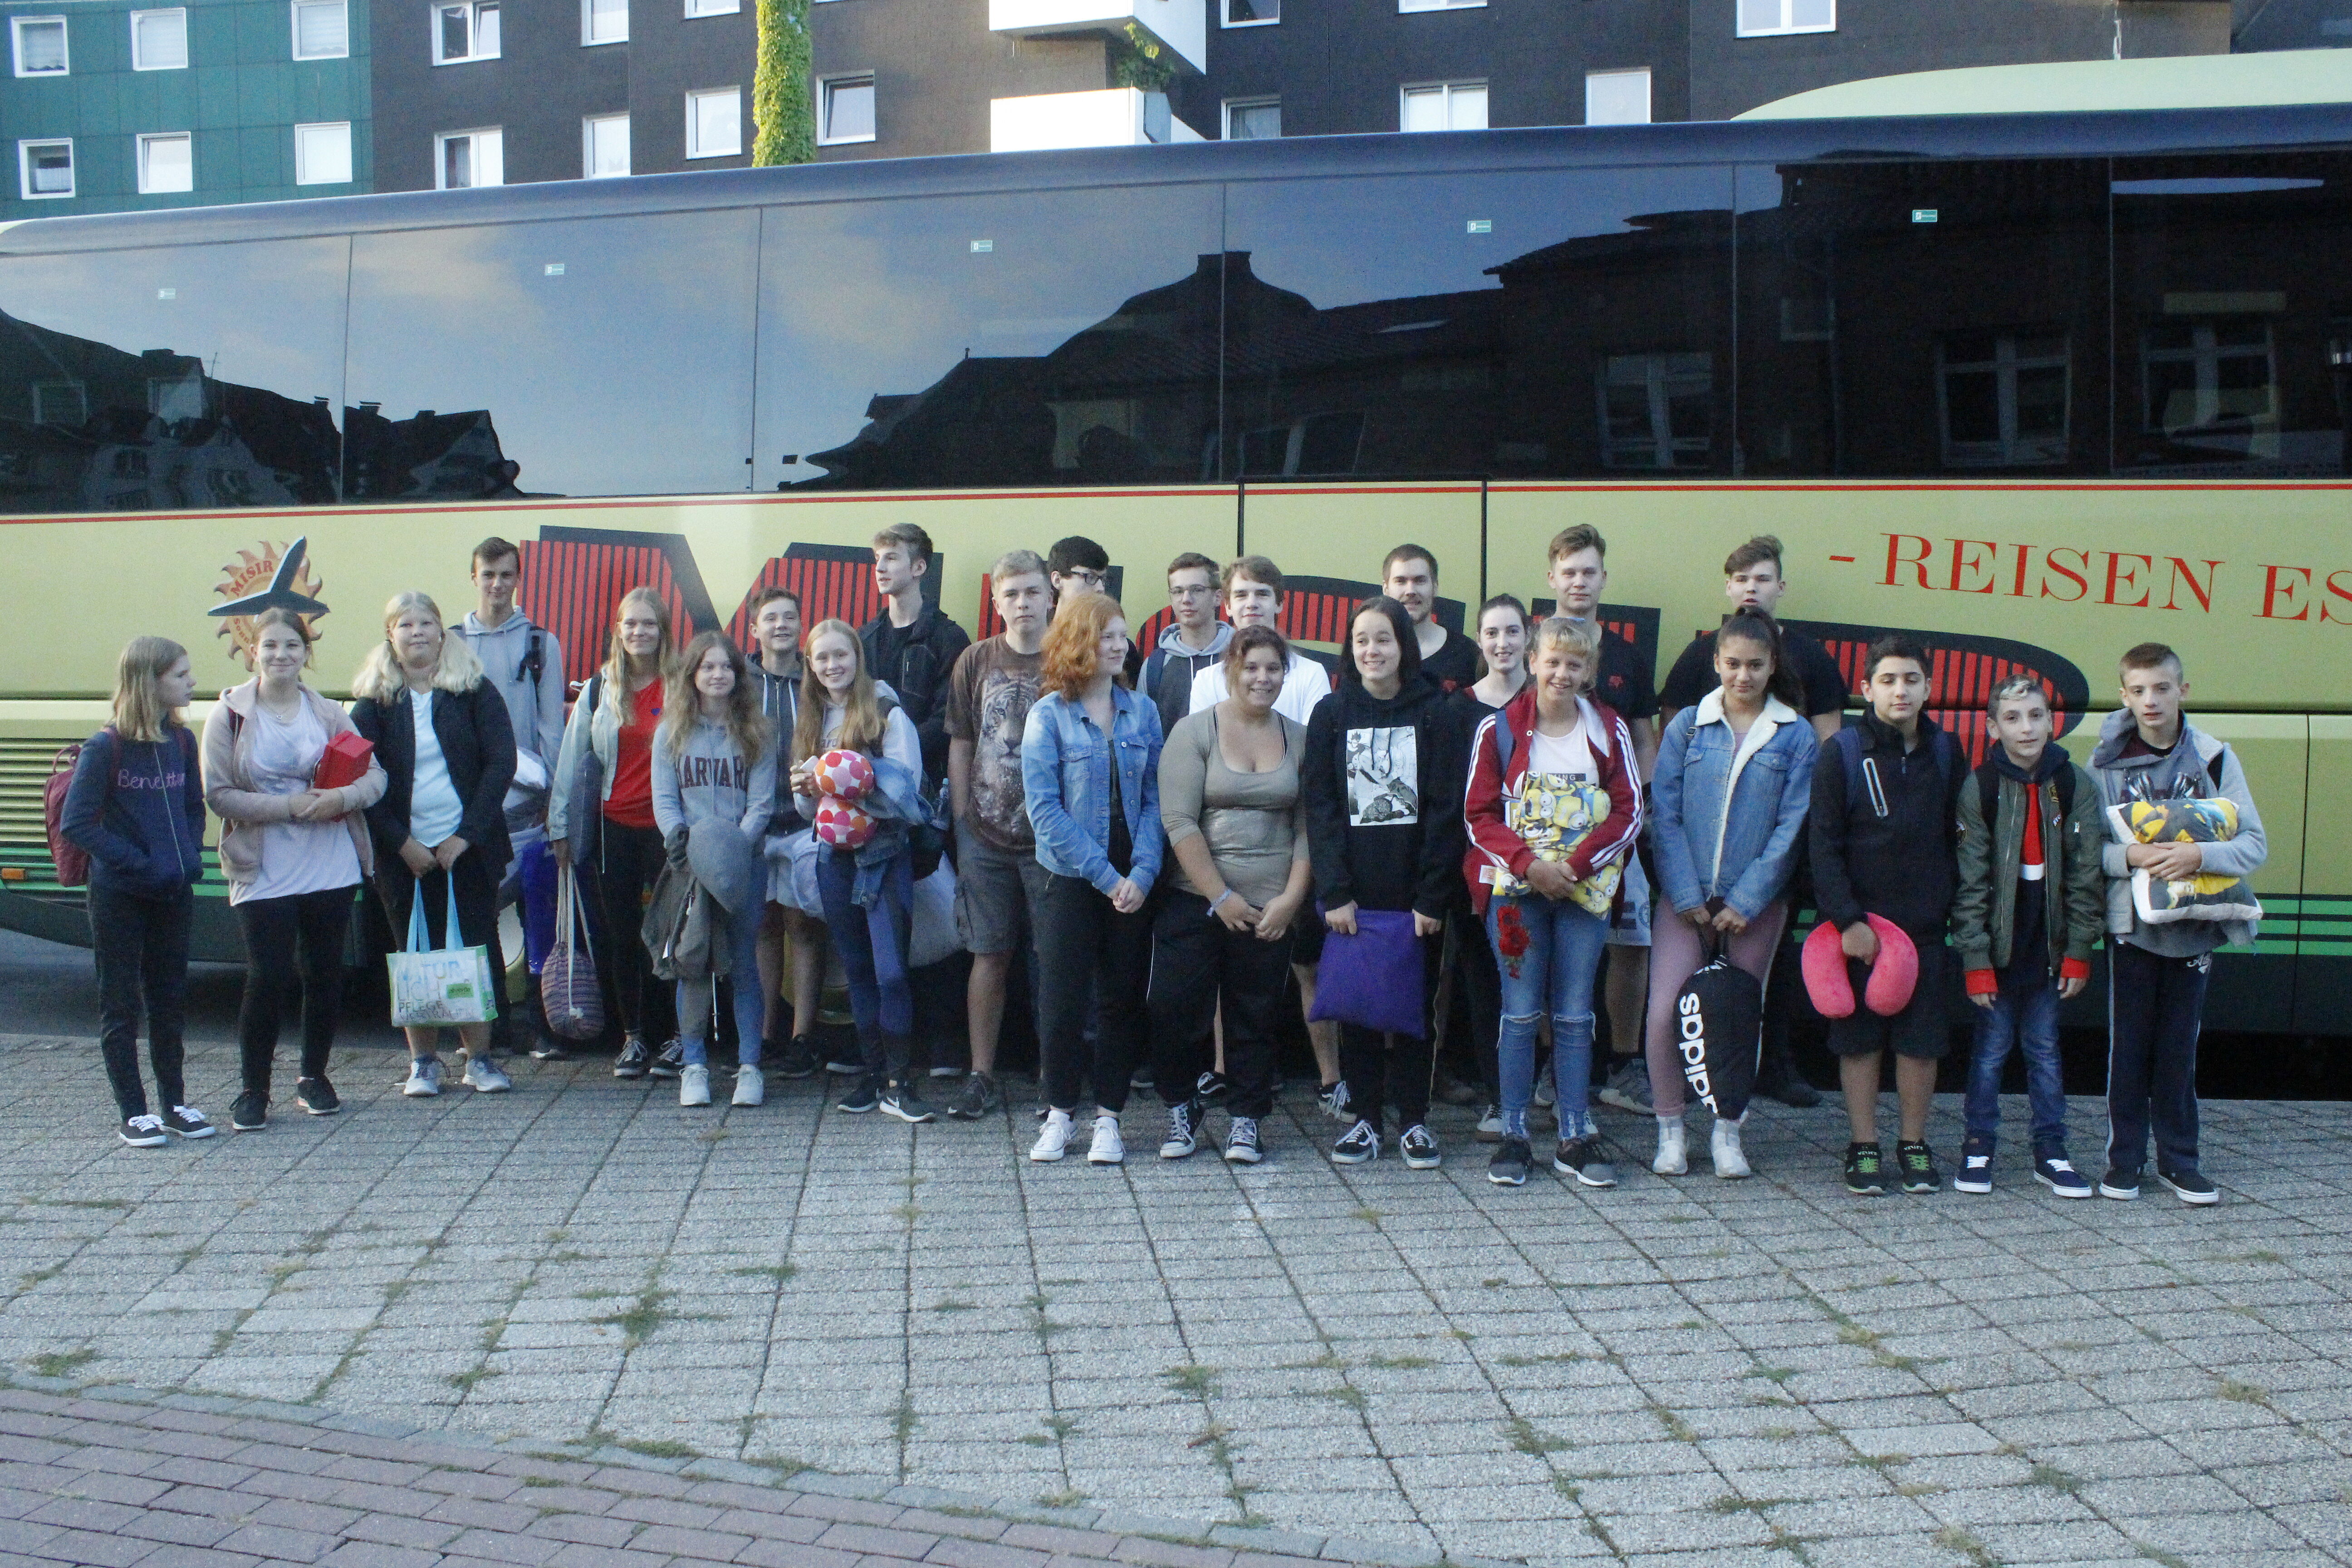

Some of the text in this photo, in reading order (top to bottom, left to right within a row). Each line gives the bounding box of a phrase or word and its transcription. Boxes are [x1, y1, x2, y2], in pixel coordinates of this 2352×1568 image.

[230, 560, 274, 597] MISIR
[1874, 532, 2225, 613] REISEN
[675, 755, 748, 790] ARVAR
[399, 1000, 443, 1013] PFLEGE
